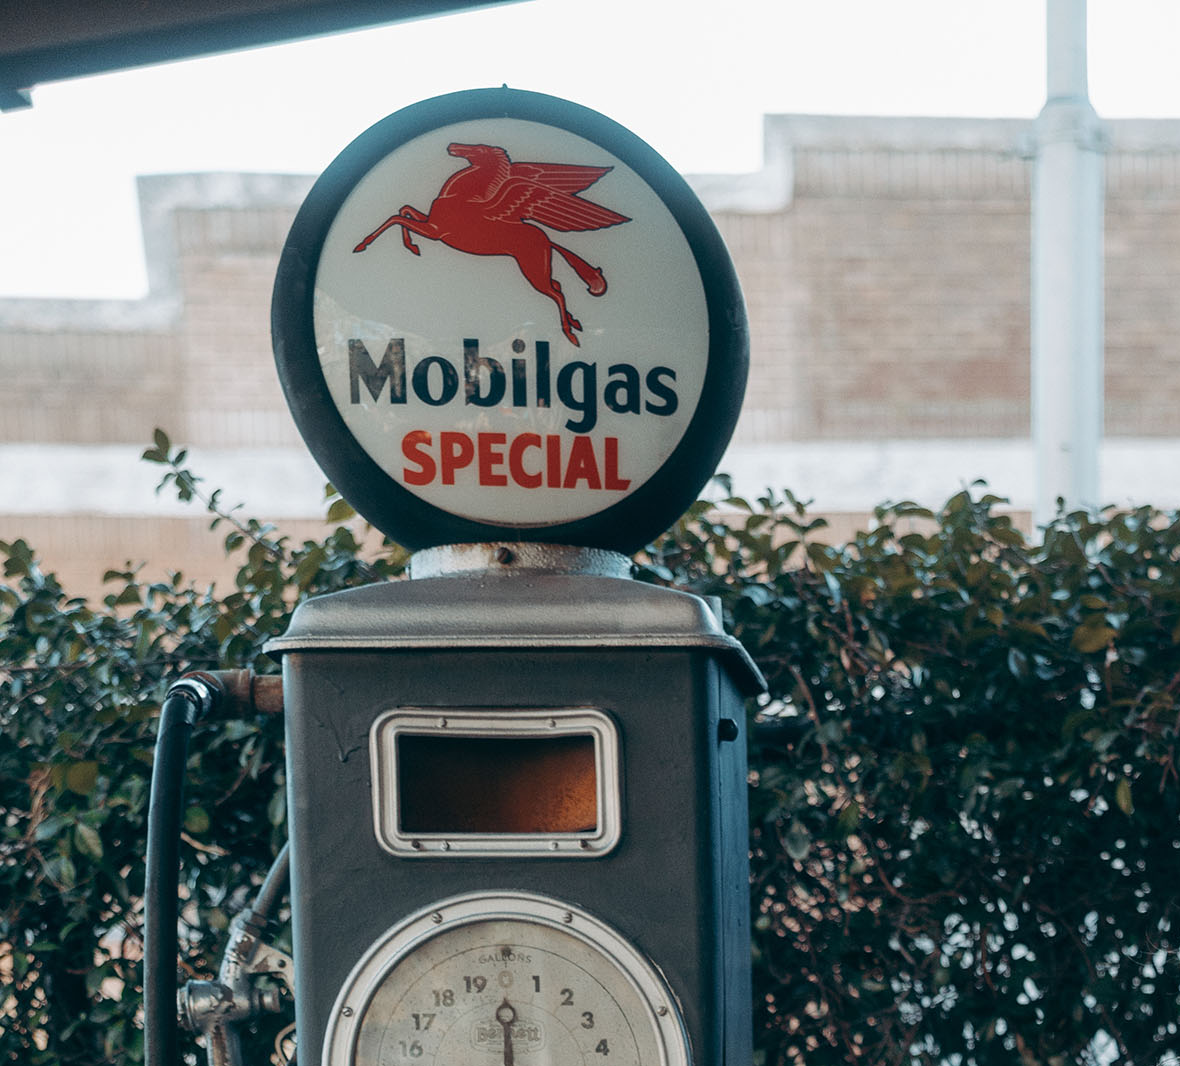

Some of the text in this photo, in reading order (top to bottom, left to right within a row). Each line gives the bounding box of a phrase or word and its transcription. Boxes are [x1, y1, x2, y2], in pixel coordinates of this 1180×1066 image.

[348, 337, 679, 433] Mobilgas
[401, 430, 632, 491] SPECIAL
[464, 976, 487, 993] 19
[532, 975, 541, 992] 1
[432, 989, 454, 1006] 18
[561, 989, 574, 1006] 2
[412, 1013, 436, 1031] 17
[581, 1012, 595, 1029] 3
[399, 1040, 423, 1058] 16
[595, 1038, 610, 1056] 4
